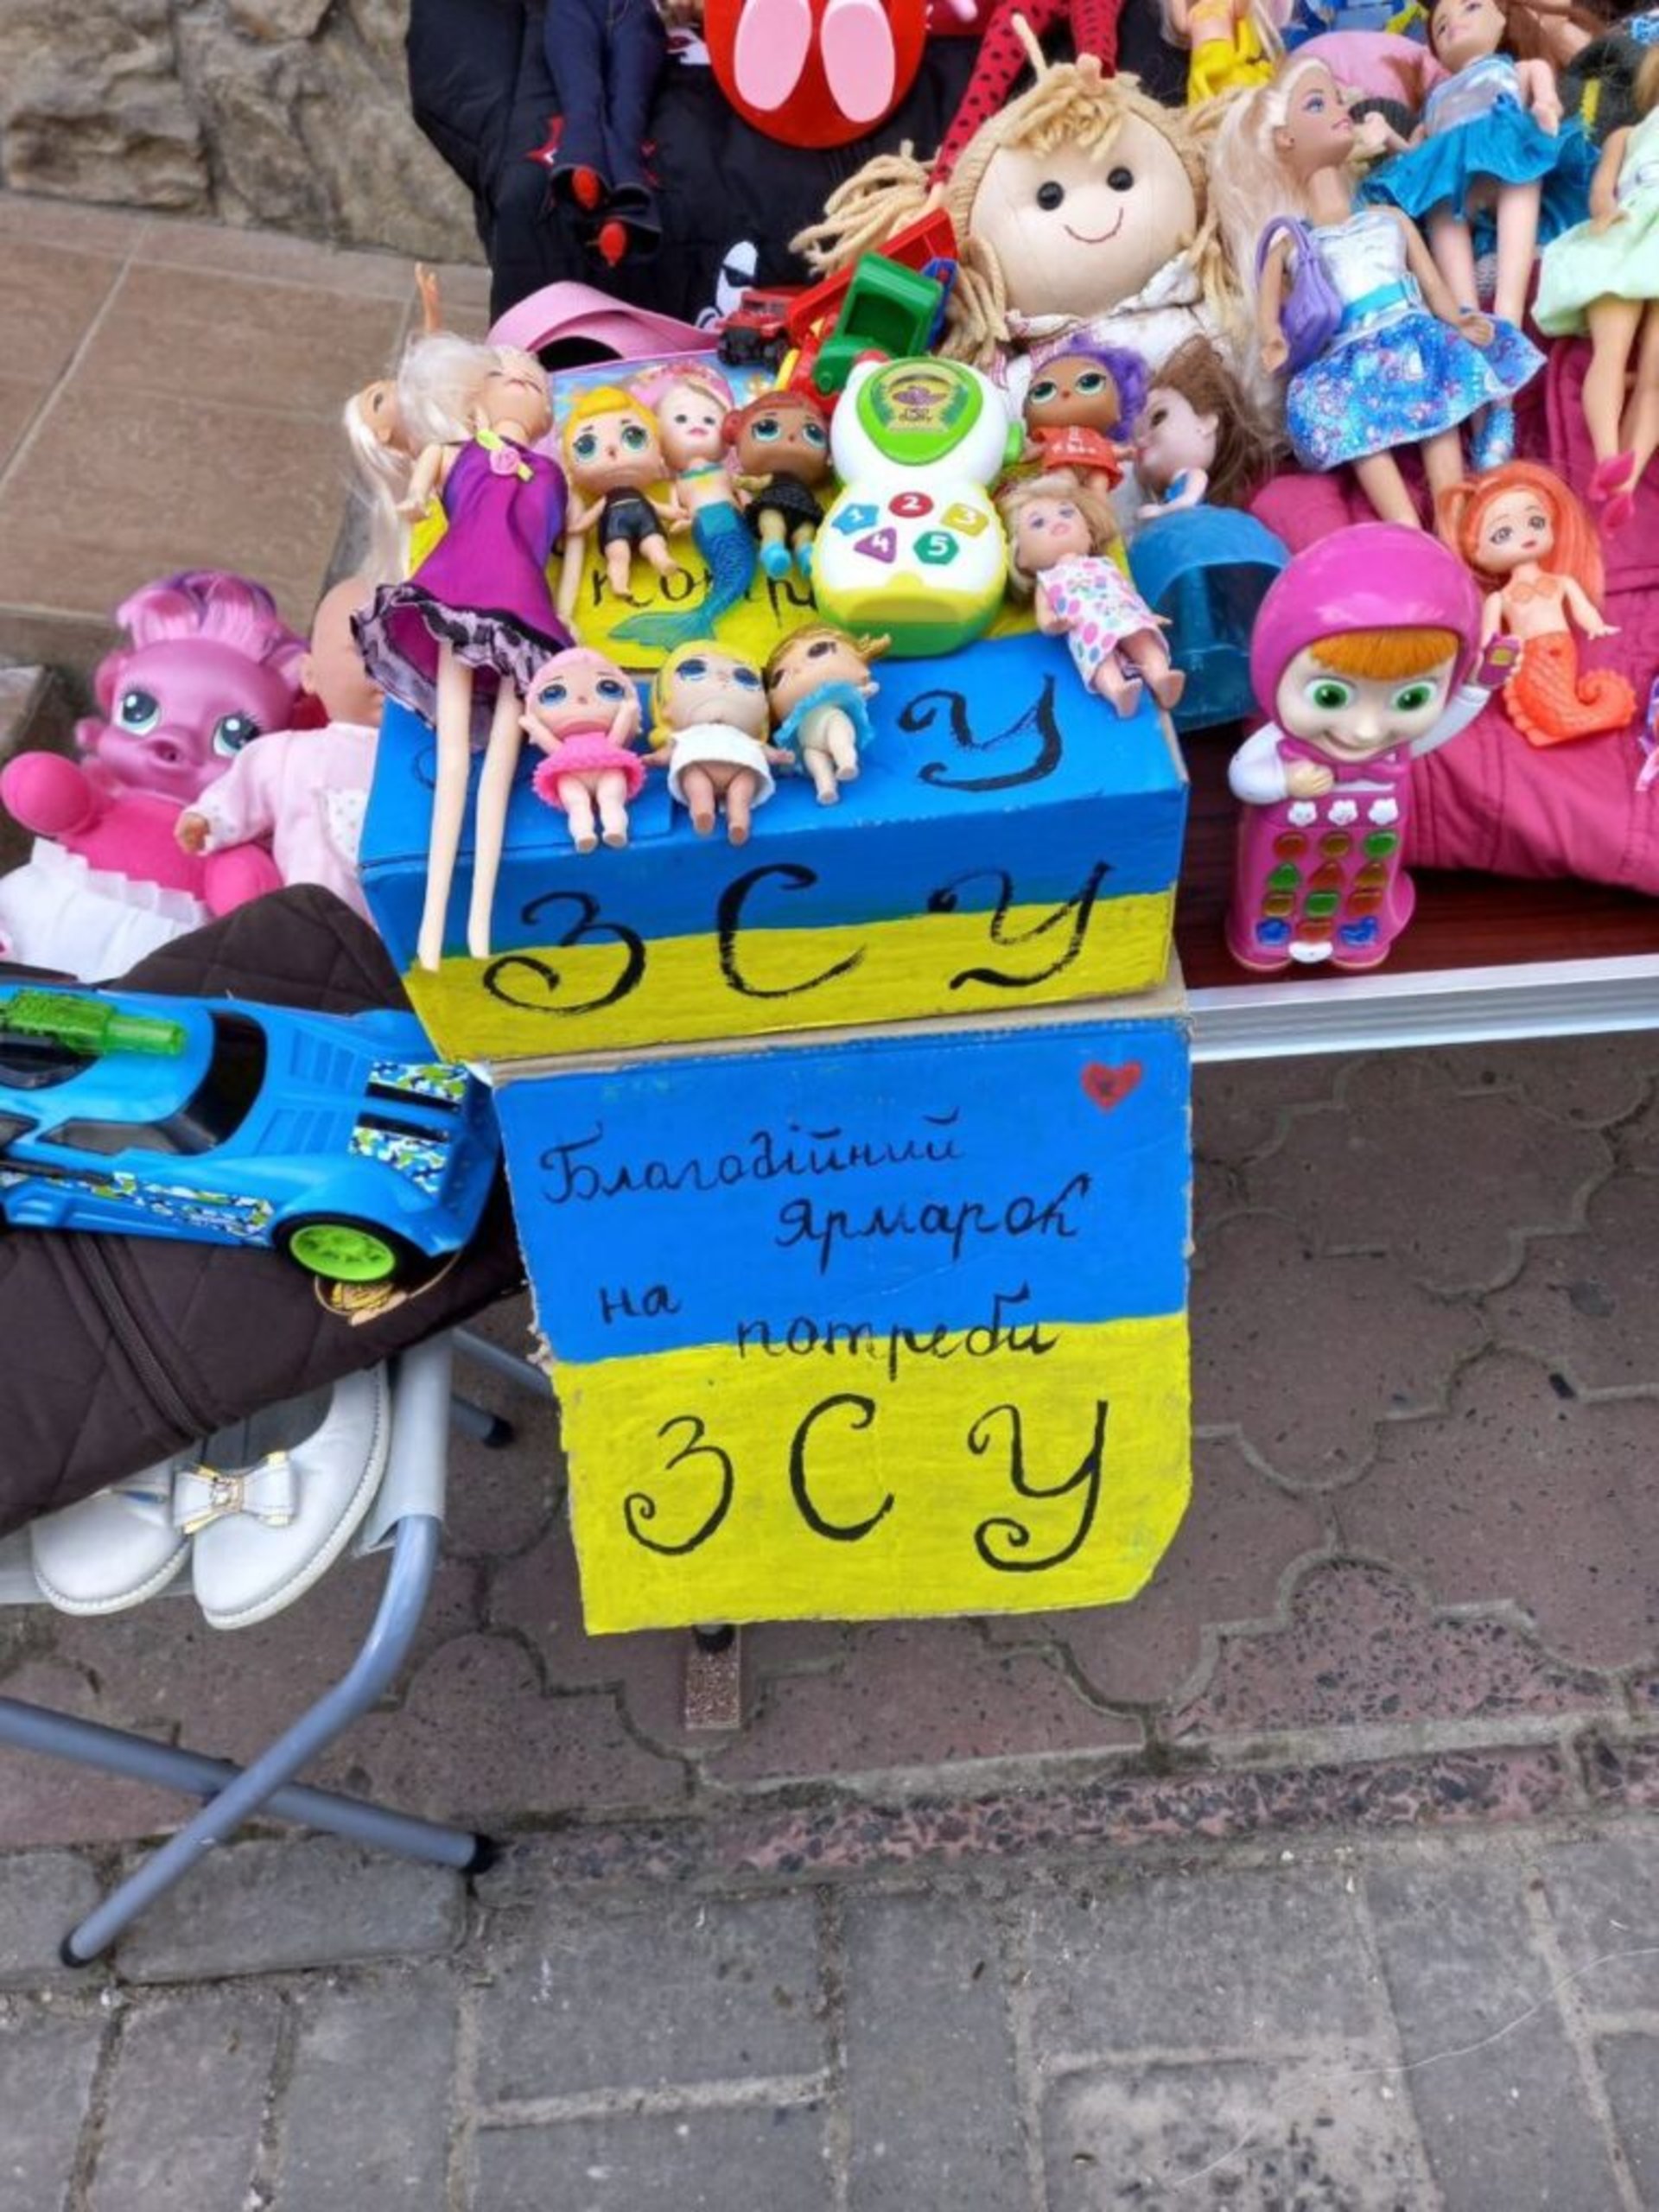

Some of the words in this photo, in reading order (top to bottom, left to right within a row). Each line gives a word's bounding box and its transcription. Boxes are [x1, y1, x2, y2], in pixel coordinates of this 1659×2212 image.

[901, 496, 921, 512] 2
[871, 532, 890, 553] 4
[928, 535, 949, 556] 5
[541, 1108, 963, 1205] Благодійний
[601, 1285, 680, 1324] на
[737, 1283, 1058, 1382] потреби
